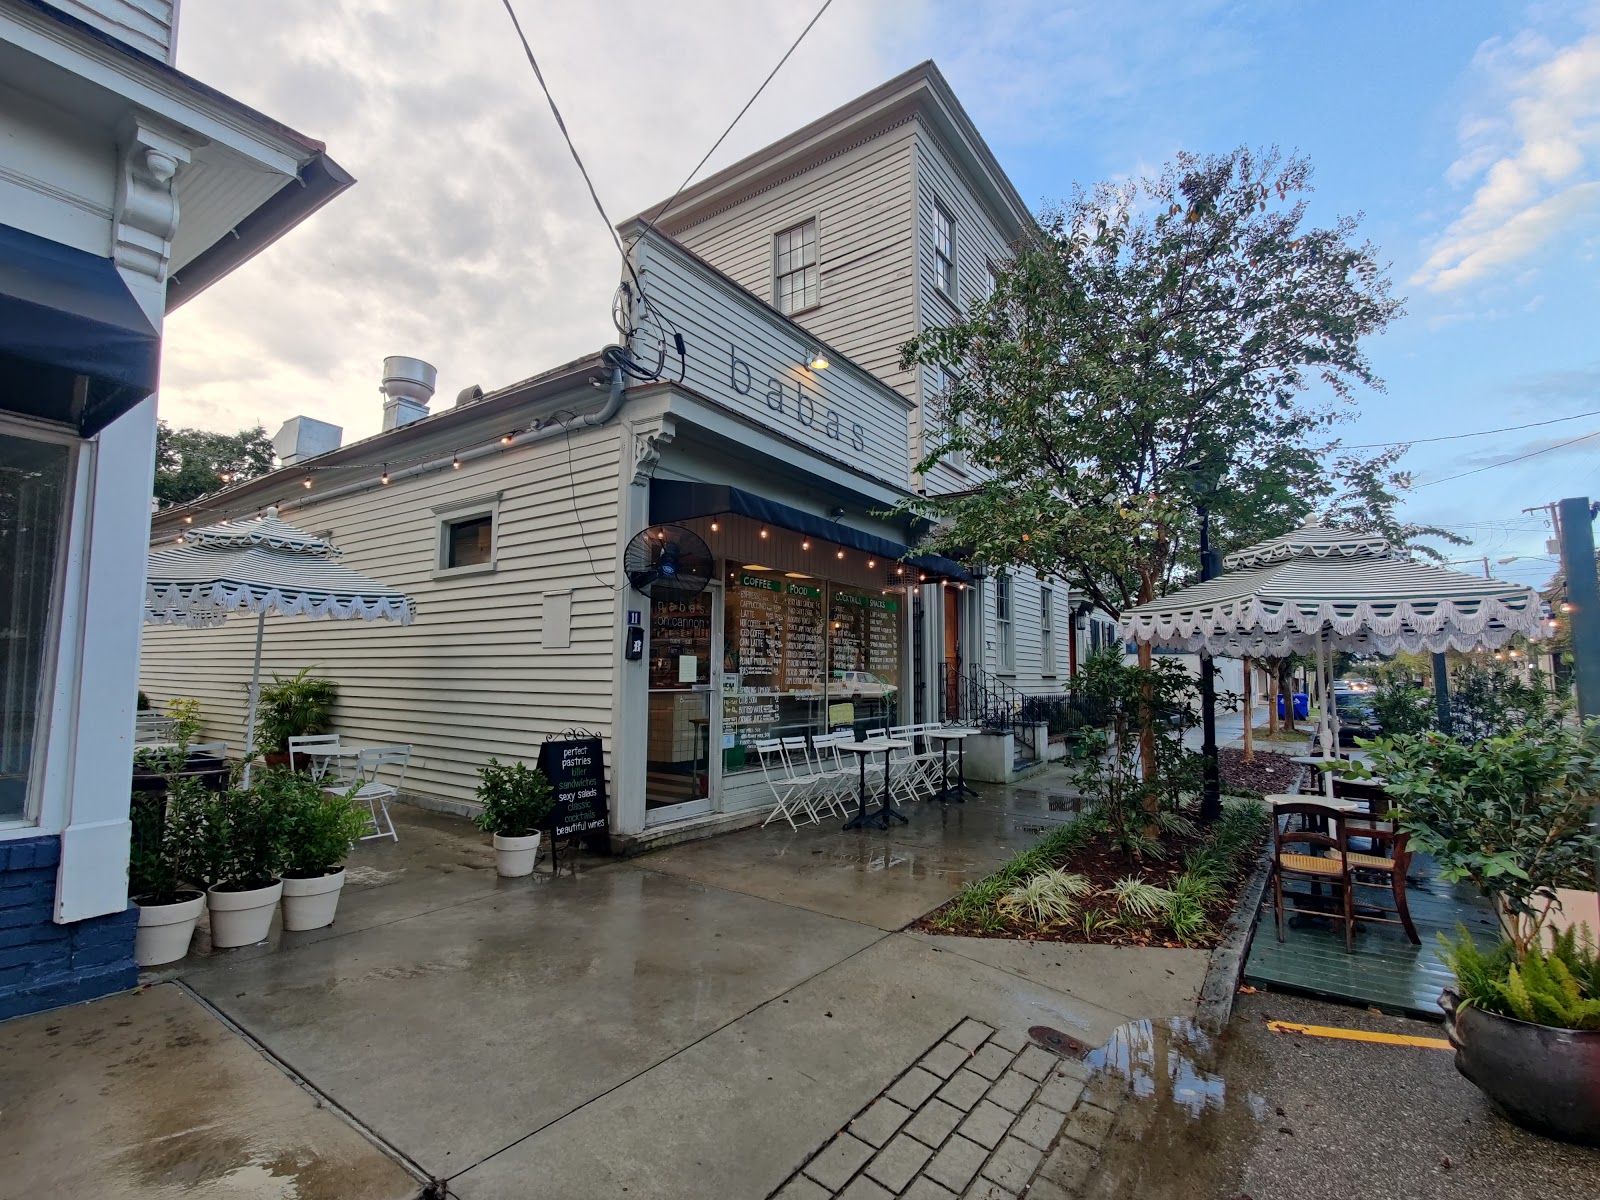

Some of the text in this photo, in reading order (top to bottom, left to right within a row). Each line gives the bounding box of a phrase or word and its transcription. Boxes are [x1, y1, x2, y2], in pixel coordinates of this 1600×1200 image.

[731, 344, 864, 452] babas
[743, 576, 772, 590] COFFEE
[790, 584, 808, 596] FOOD
[836, 592, 862, 606] COCKTAILS
[869, 599, 886, 609] SNACKS
[631, 612, 638, 624] 11
[740, 609, 755, 619] LATTE
[672, 617, 705, 628] cannon
[563, 746, 588, 759] perfect
[561, 757, 592, 770] pastries
[559, 777, 597, 790] sandwiches
[558, 788, 597, 803] sexy salads
[567, 799, 592, 812] classic
[564, 812, 596, 823] cocktails
[556, 818, 605, 836] beautiful wines
